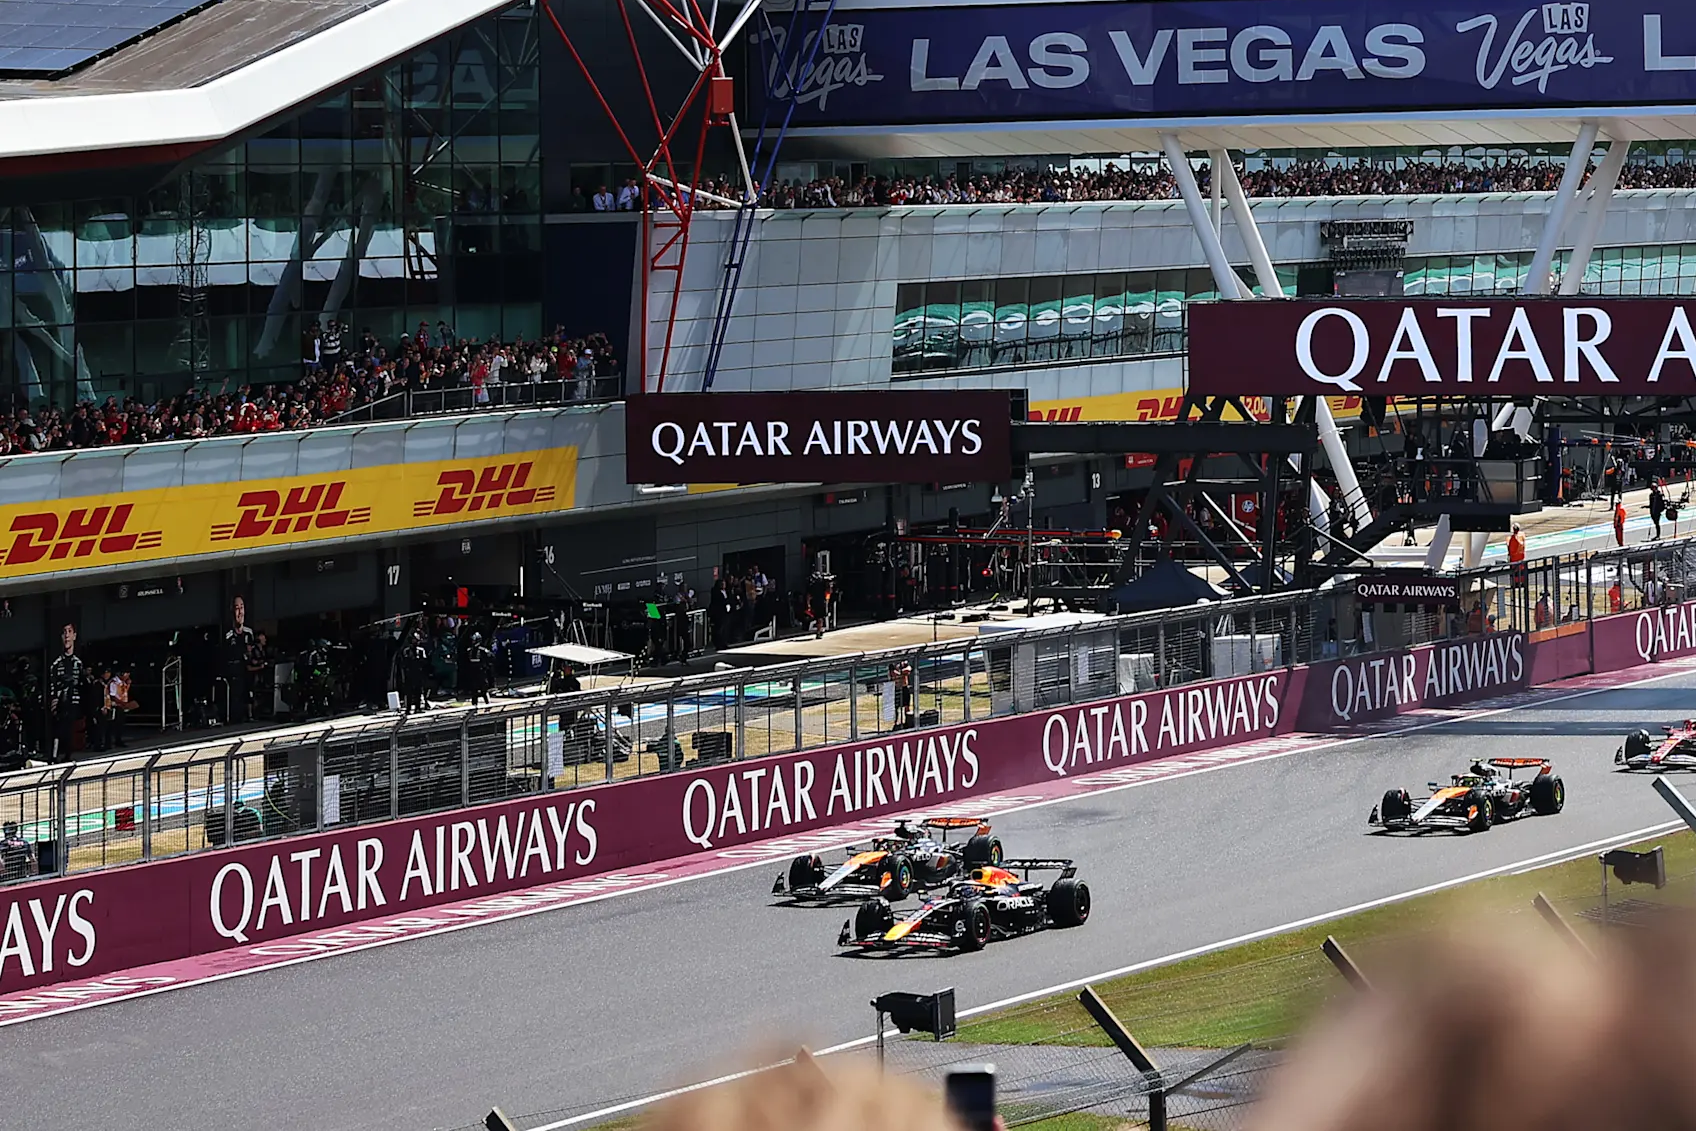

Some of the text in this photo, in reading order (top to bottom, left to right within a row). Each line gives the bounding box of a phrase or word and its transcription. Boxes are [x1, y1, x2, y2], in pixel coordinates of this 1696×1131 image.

[825, 25, 862, 52] LAS
[1544, 2, 1589, 33] LAS
[909, 23, 1427, 92] LAS VEGAS
[1457, 12, 1614, 93] Vegas
[1295, 304, 1621, 391] QATAR
[651, 419, 983, 465] QATAR AIRWAYS
[433, 462, 538, 515] DHL
[1091, 473, 1101, 488] 13
[4, 503, 141, 565] DHL
[233, 481, 352, 540] DHL
[387, 565, 400, 585] 17
[1357, 584, 1456, 598] QATAR AIRWAYS
[1331, 633, 1523, 720] QATAR AIRWAYS
[1042, 675, 1279, 776] QATAR AIRWAYS
[682, 729, 979, 850] QATAR AIRWAYS
[210, 798, 598, 943] QATAR AIRWAYS
[997, 896, 1035, 911] ORACLE
